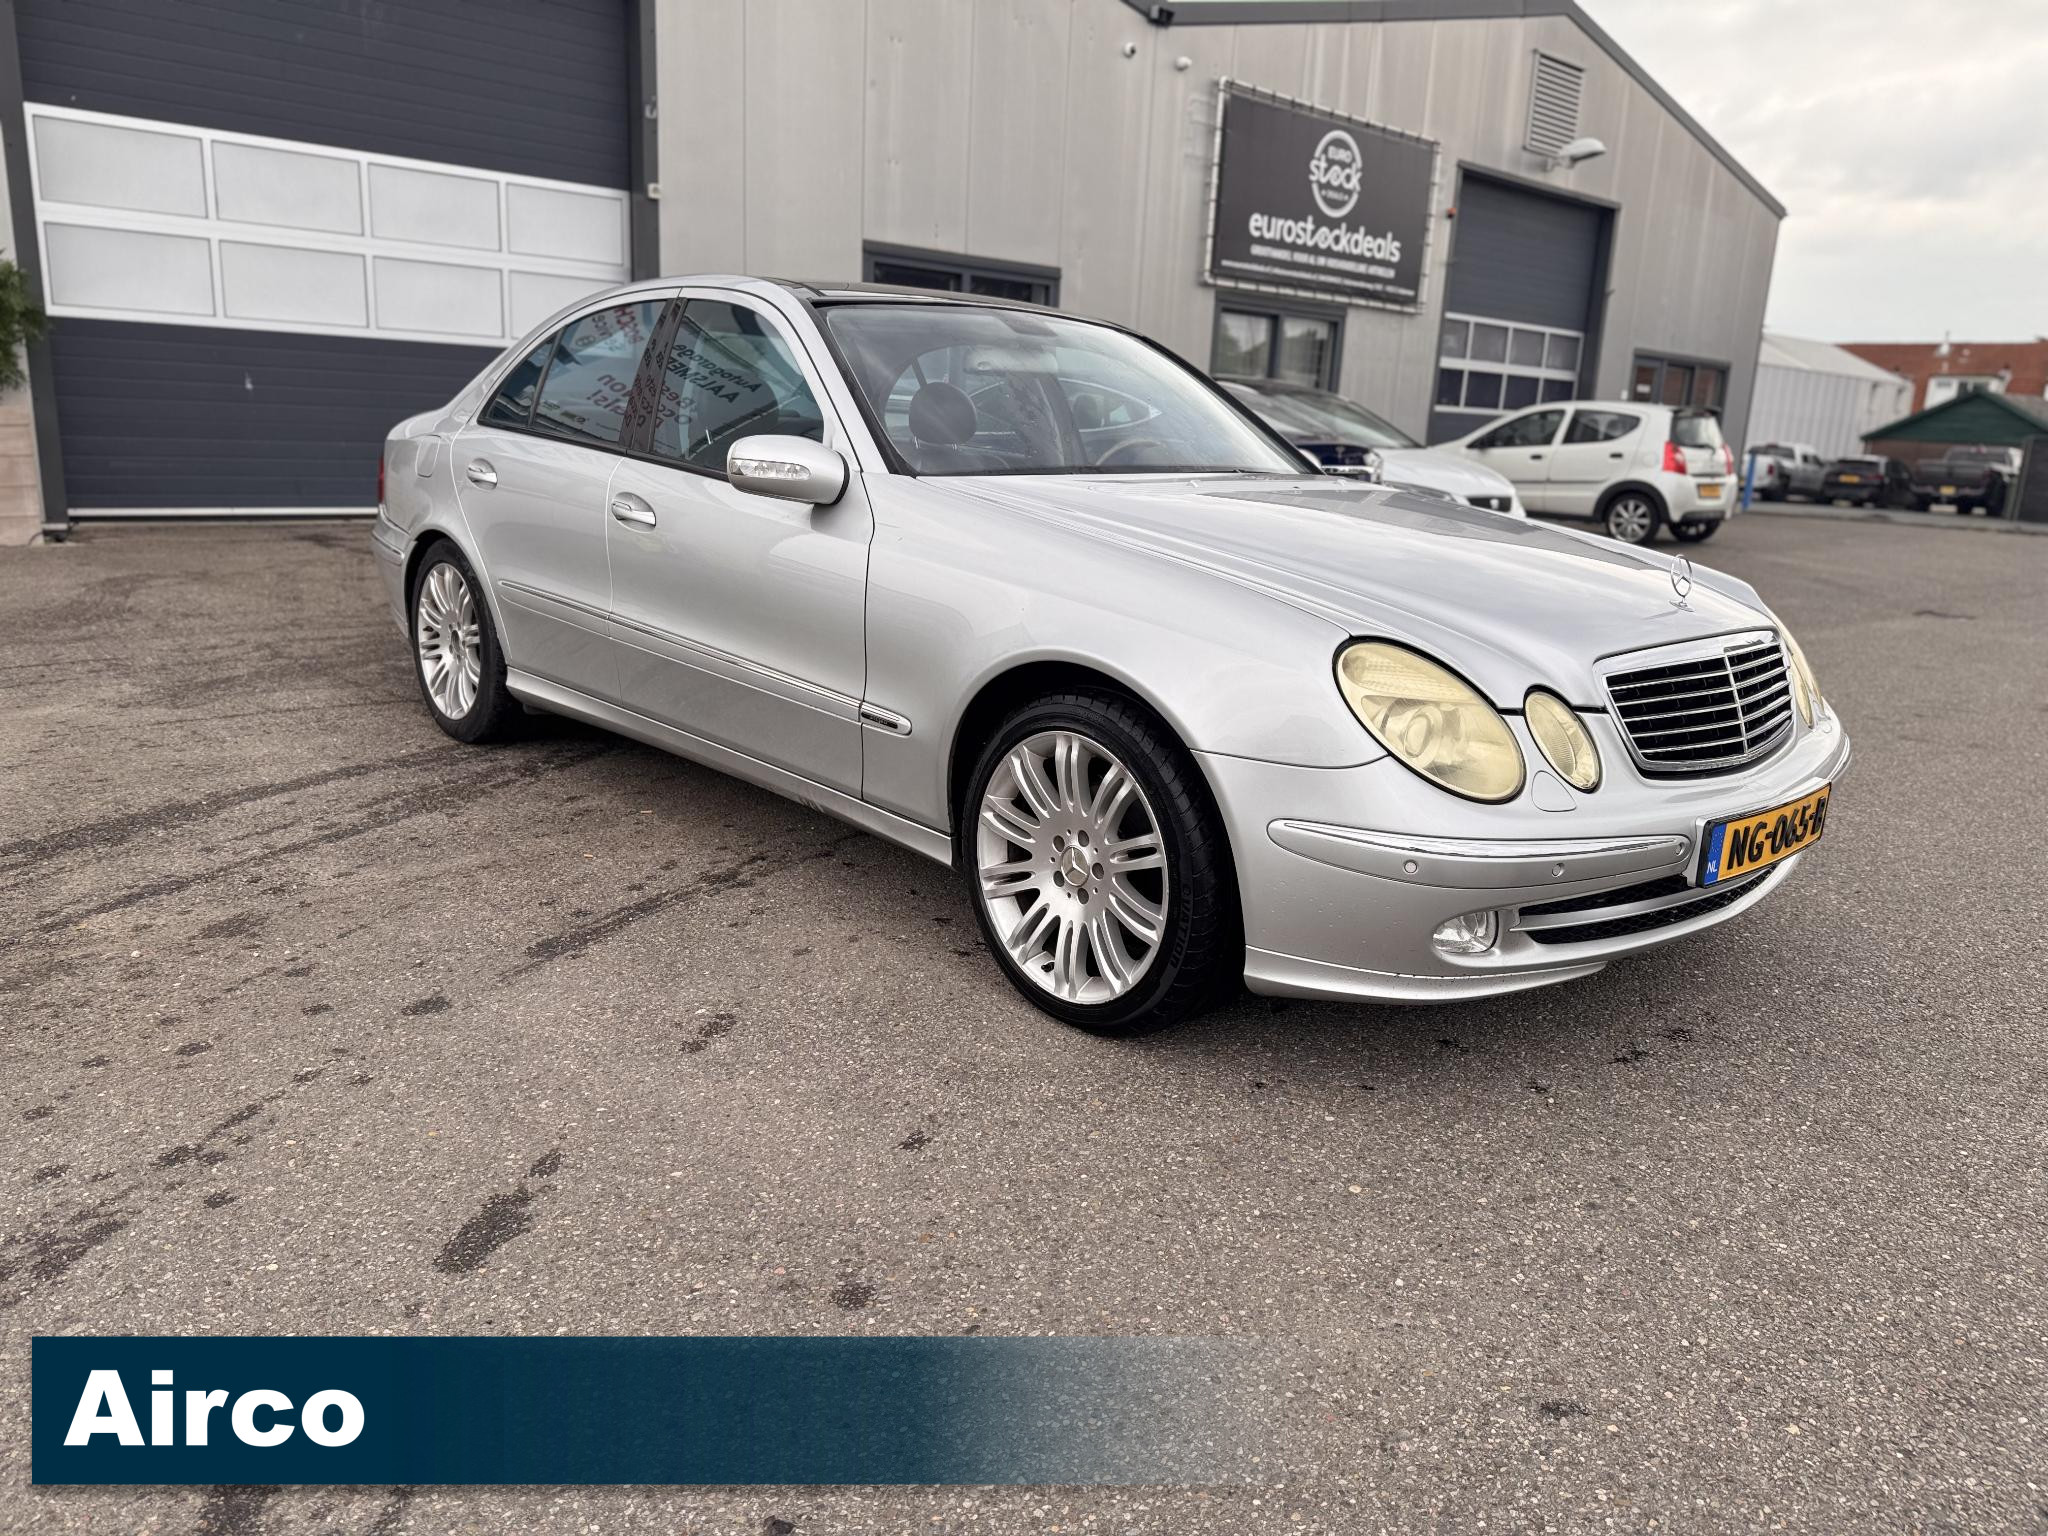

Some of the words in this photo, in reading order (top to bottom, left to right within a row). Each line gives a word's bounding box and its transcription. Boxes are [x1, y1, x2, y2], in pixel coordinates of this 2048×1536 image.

[1309, 154, 1363, 192] stock
[1327, 146, 1353, 163] EURO
[1249, 212, 1402, 263] eurostockdeals
[1727, 796, 1826, 870] NG-065-B
[1707, 860, 1718, 874] NL
